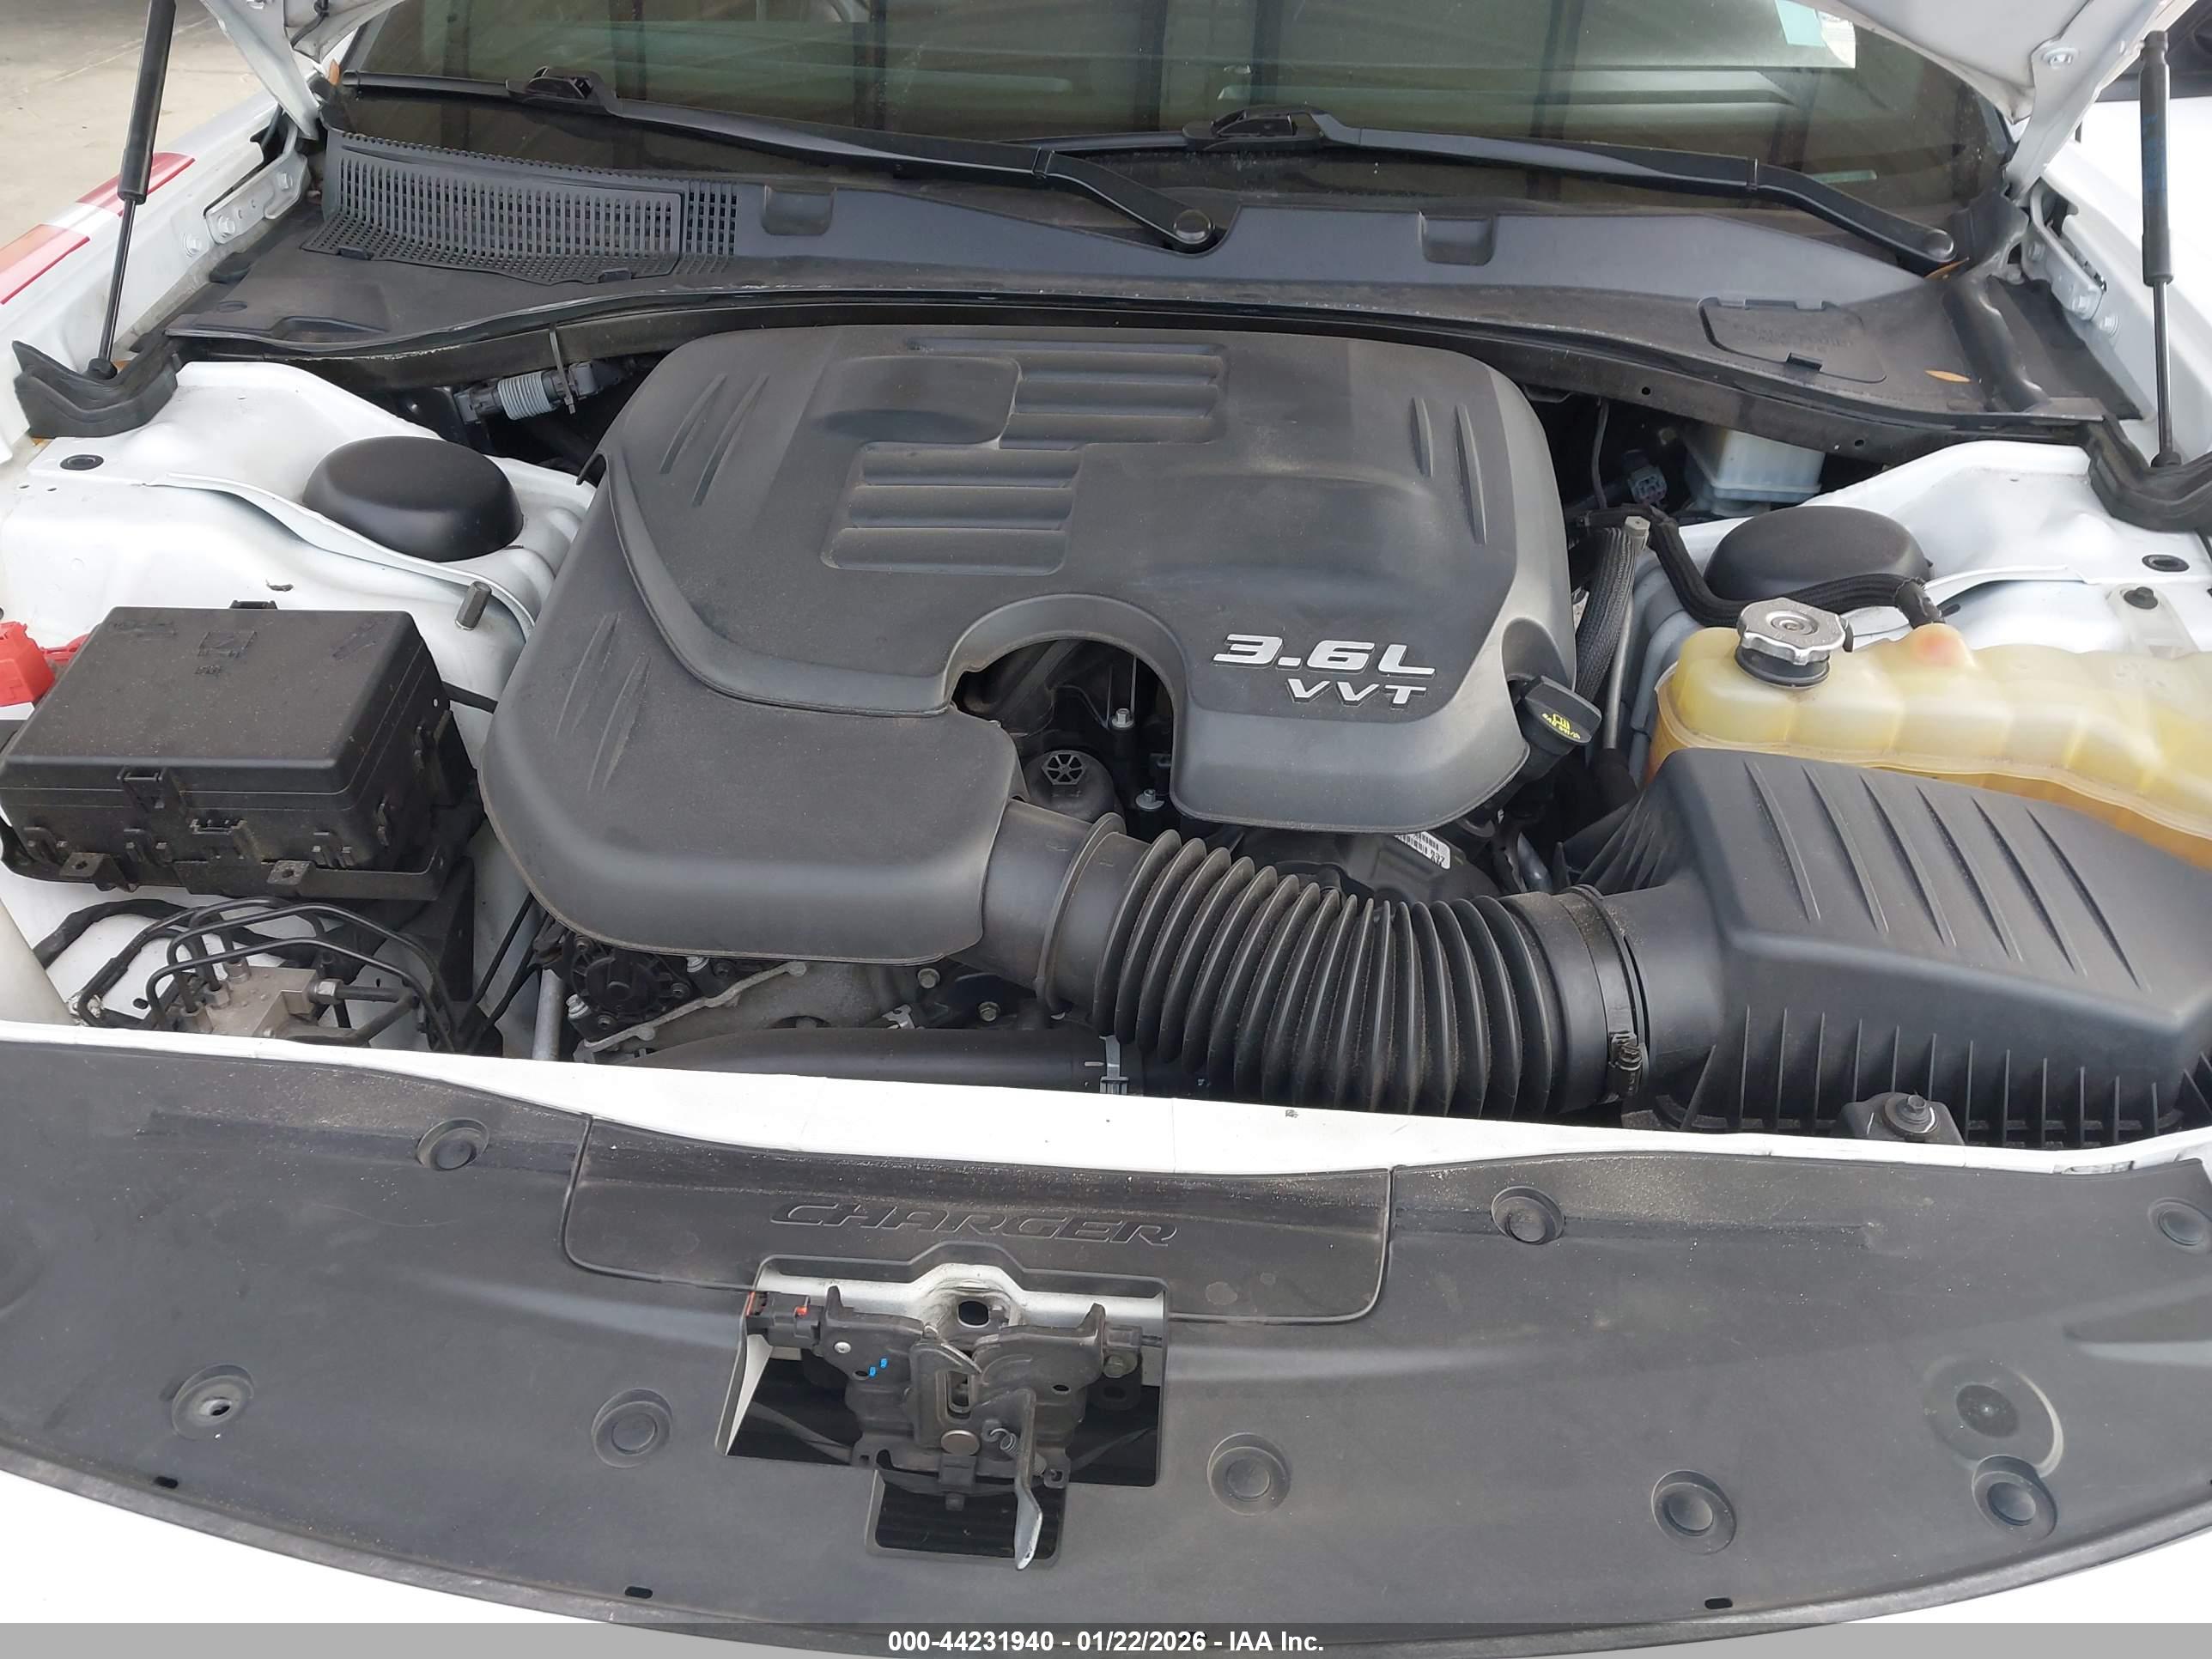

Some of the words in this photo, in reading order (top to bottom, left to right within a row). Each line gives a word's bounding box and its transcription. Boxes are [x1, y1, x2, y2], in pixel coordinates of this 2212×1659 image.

[1212, 634, 1437, 678] 3.6L
[1285, 678, 1428, 709] VVT
[771, 1202, 1177, 1248] CHARGER
